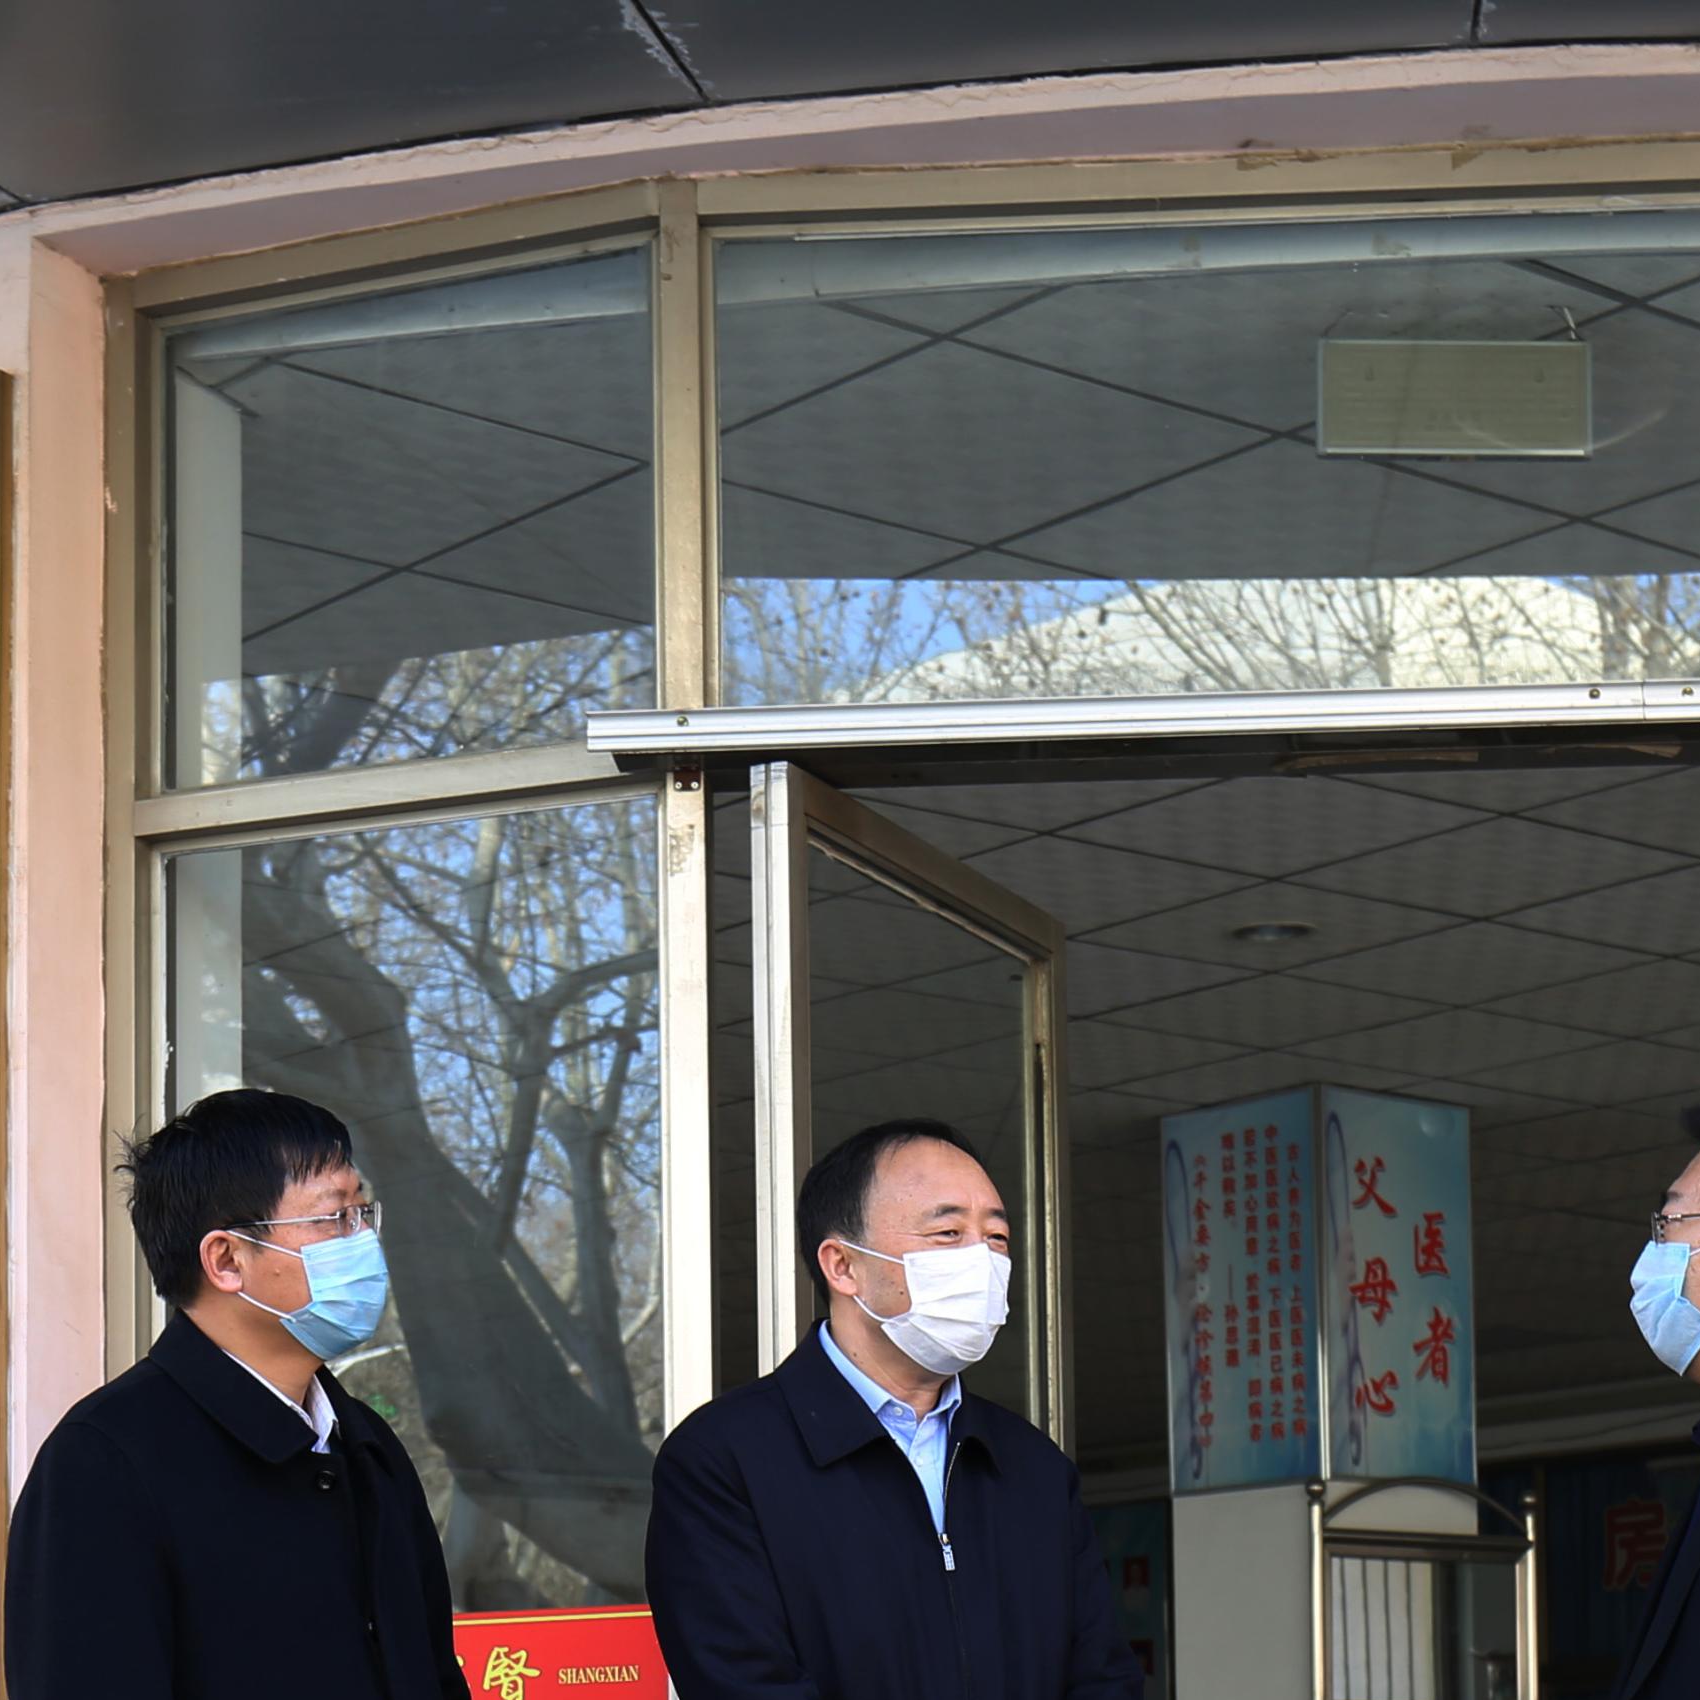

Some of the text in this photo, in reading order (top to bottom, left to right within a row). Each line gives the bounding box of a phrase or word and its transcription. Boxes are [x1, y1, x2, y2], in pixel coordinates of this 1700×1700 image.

[1349, 1155, 1398, 1417] 父母心
[1412, 1211, 1457, 1386] 医者
[558, 1664, 640, 1685] SHANGXIAN
